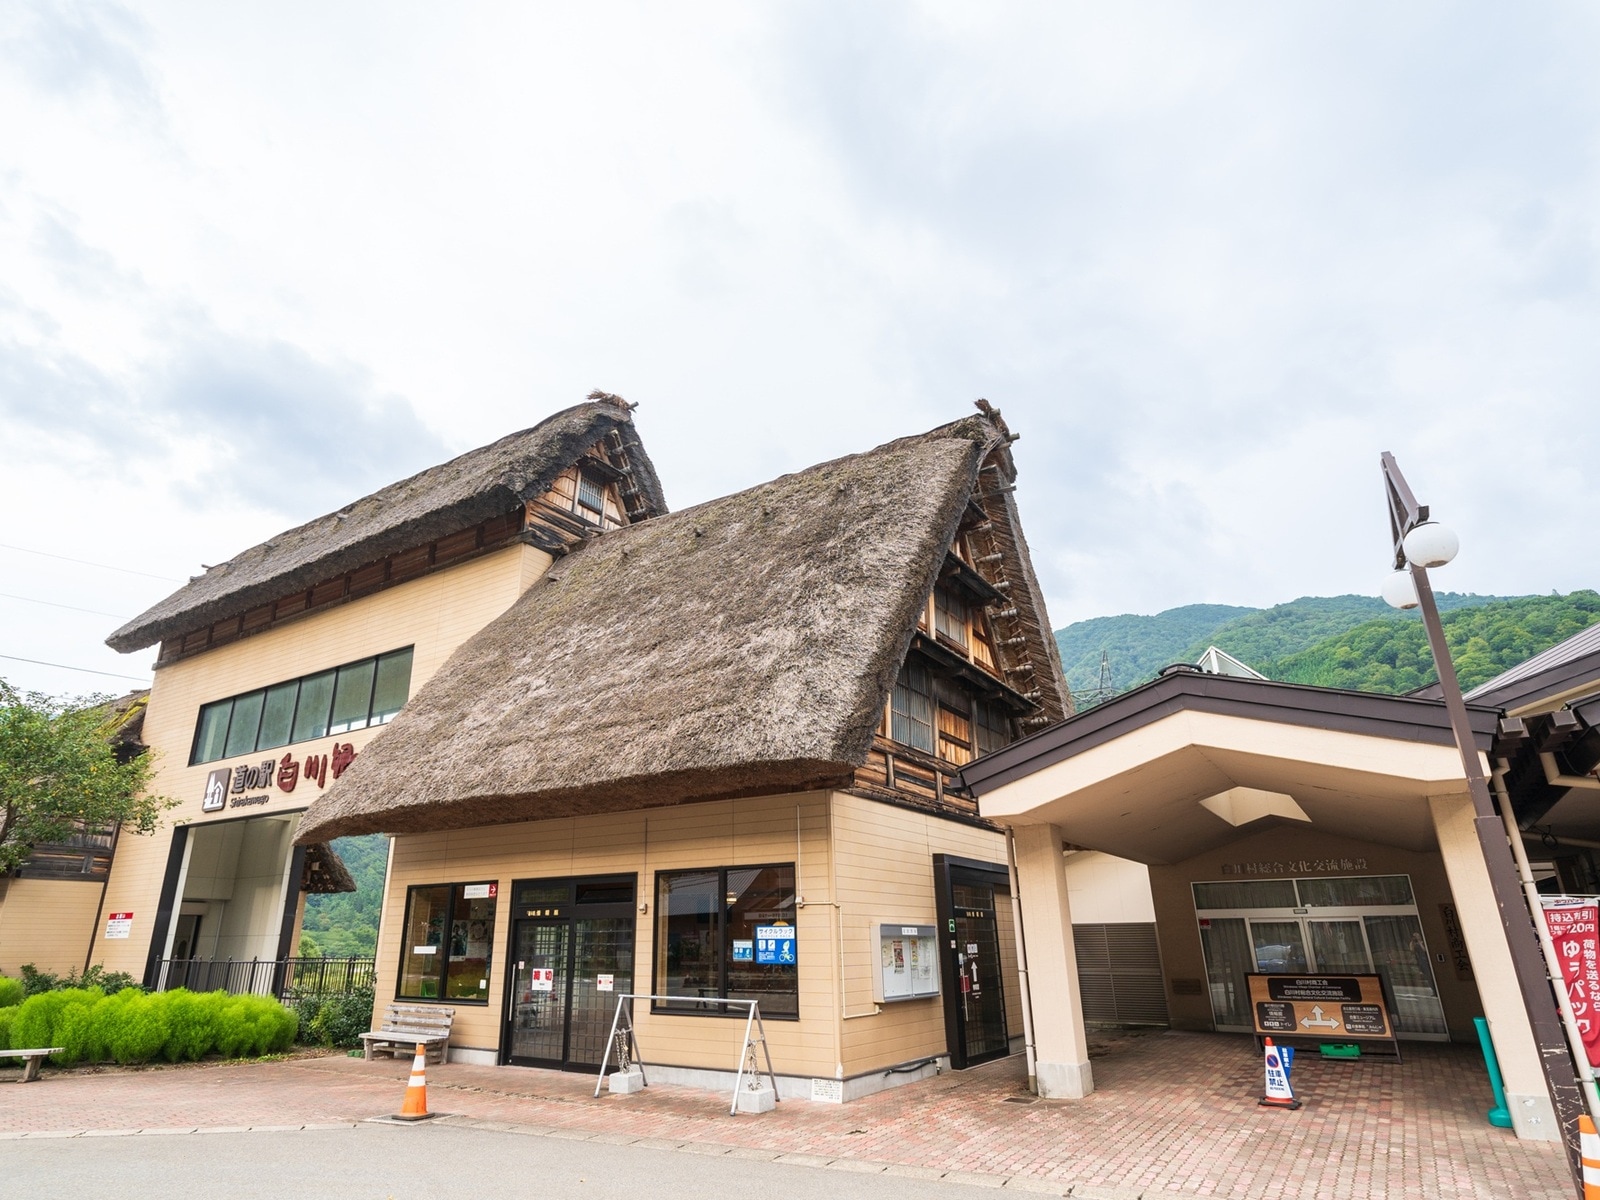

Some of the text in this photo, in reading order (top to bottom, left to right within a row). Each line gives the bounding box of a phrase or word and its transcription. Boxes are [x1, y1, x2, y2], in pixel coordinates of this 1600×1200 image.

[230, 759, 276, 794] 道の駅
[230, 794, 270, 808] Shirakawago
